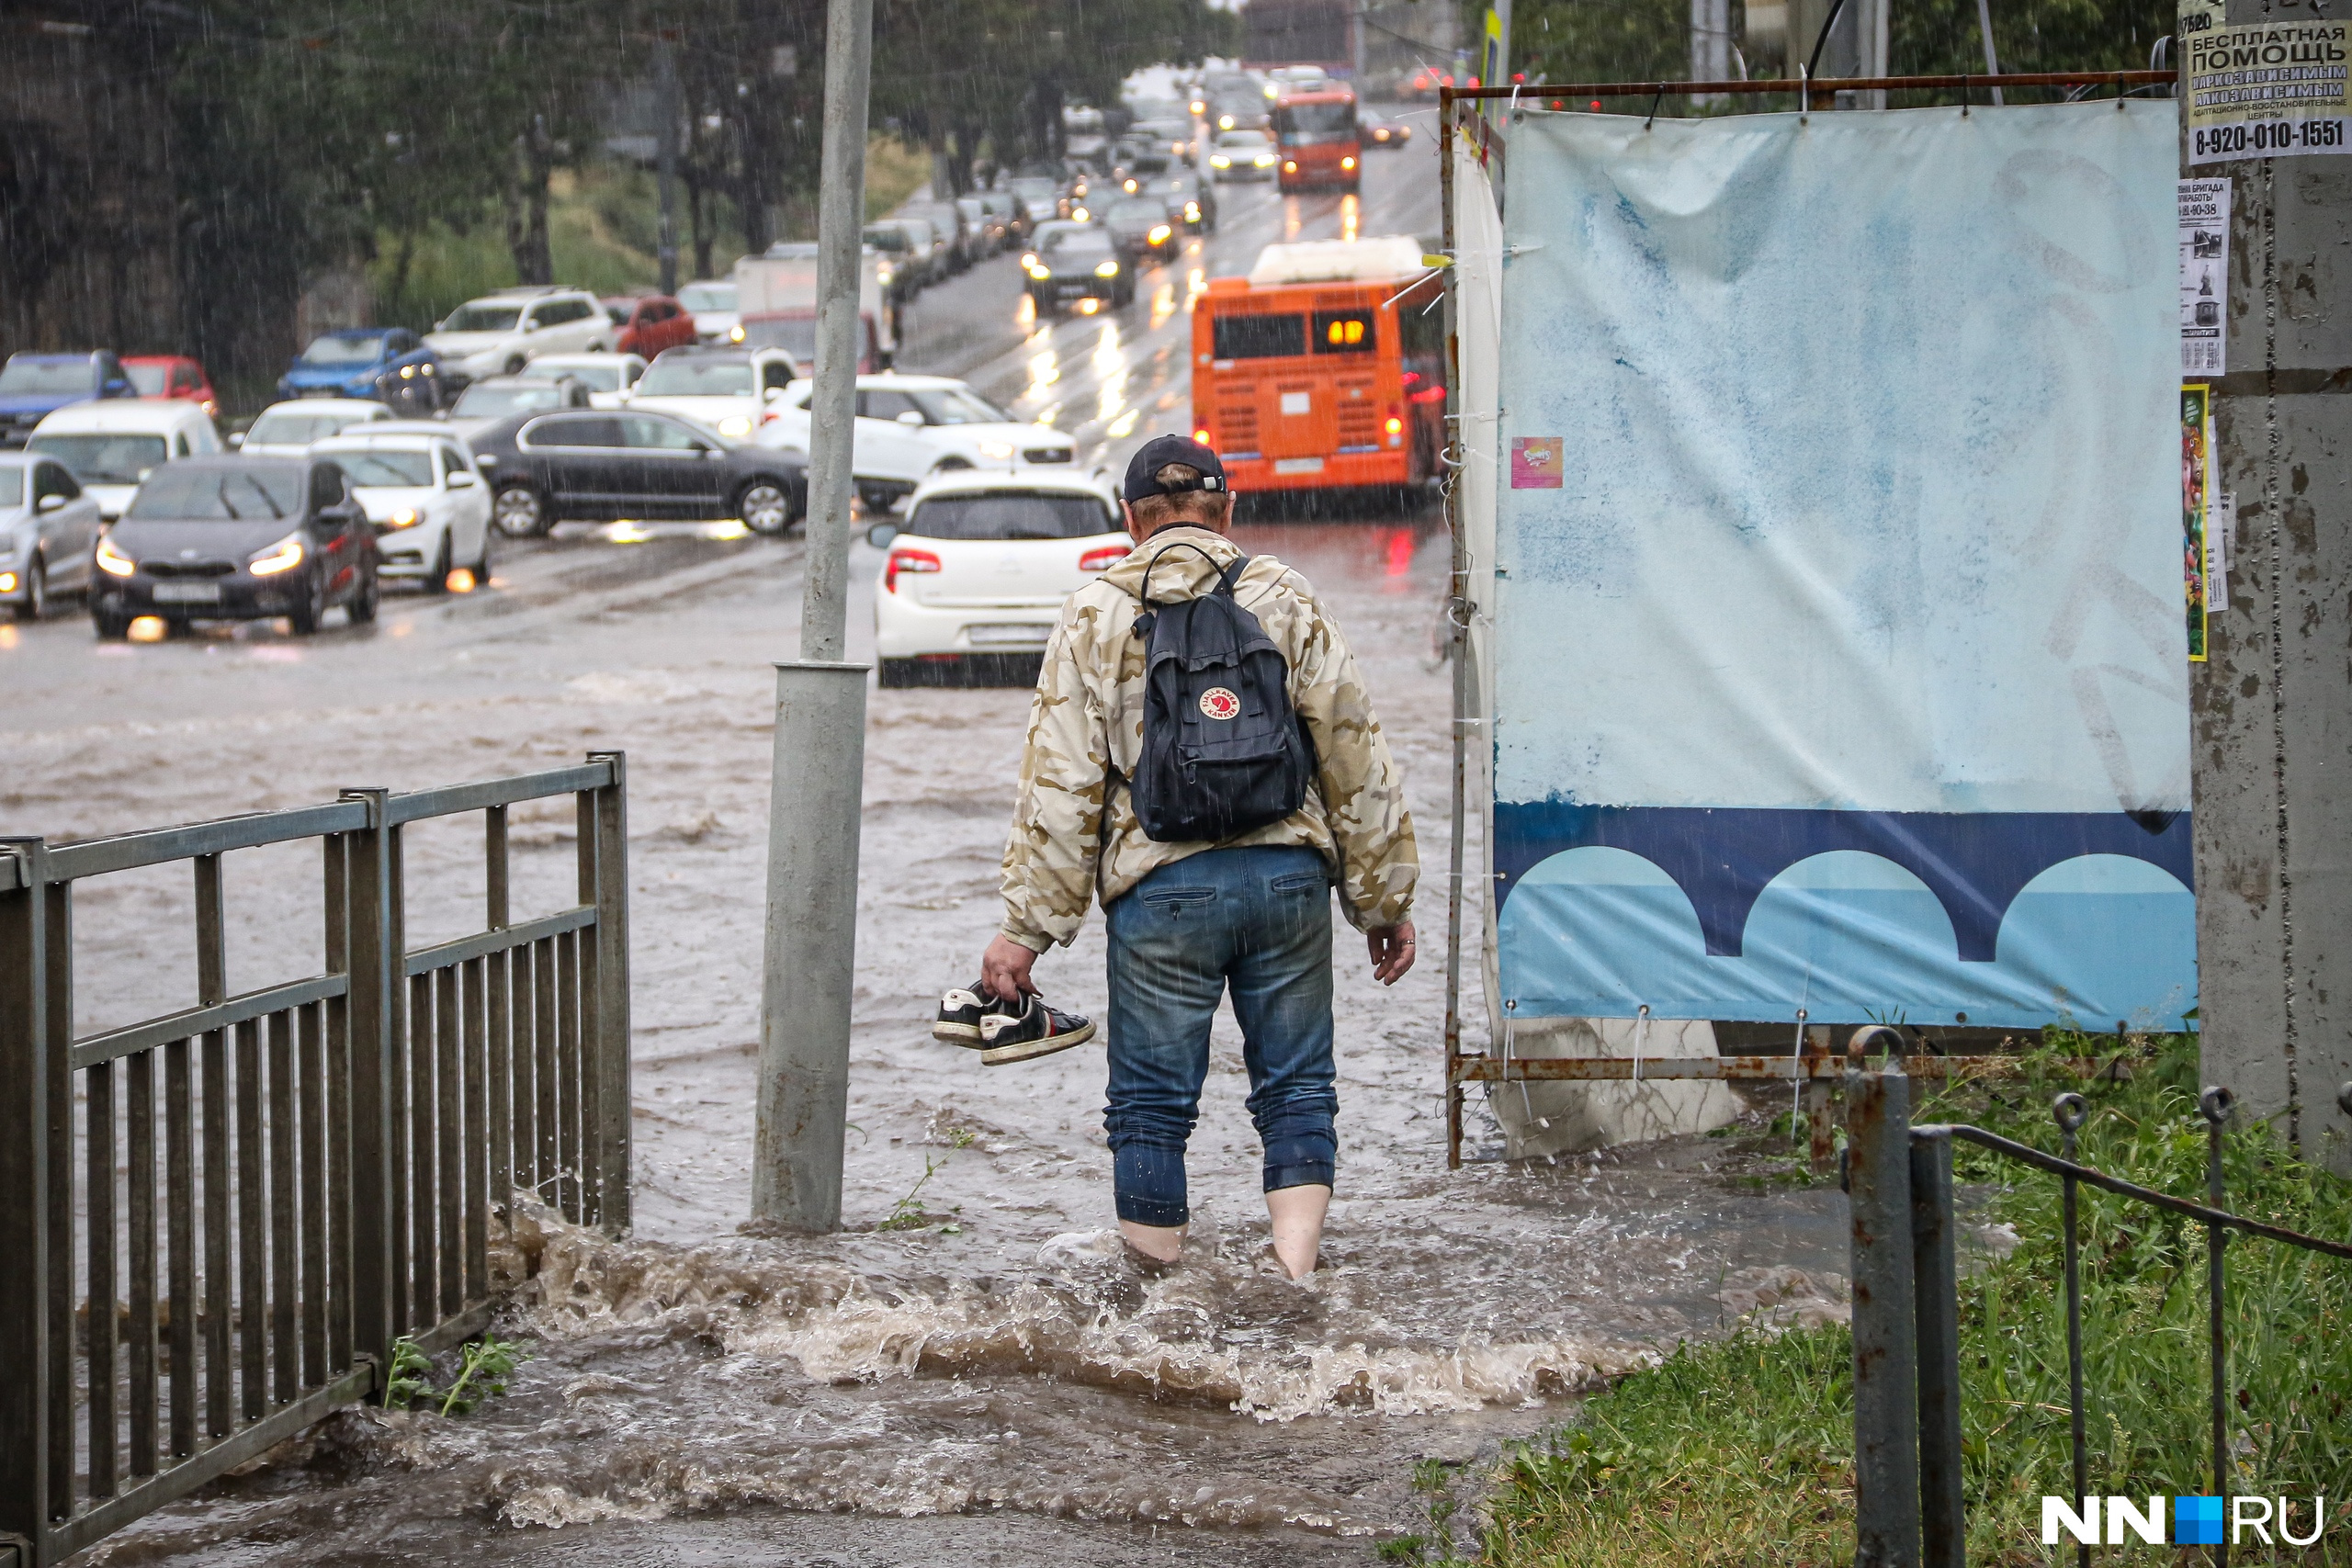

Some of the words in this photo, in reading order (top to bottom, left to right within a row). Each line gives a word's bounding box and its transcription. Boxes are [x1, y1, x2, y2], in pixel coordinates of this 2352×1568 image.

[2193, 28, 2346, 51] БЕСПЛАТНАЯ
[2192, 43, 2346, 72] ПОМОЩЬ
[2192, 65, 2347, 90] НАРКОЗАВИСИМЫМ
[2195, 83, 2344, 107] АЛКОЗАВИСИМЫМ
[2193, 98, 2347, 117] АДАПТАЦИОННО-ВОССТАНОВИТЕЛЬНЫЕ
[2247, 111, 2283, 120] ЦЕНТРЫ
[2196, 120, 2343, 156] 8-920-010-1551
[2192, 184, 2223, 193] БРИГАДА
